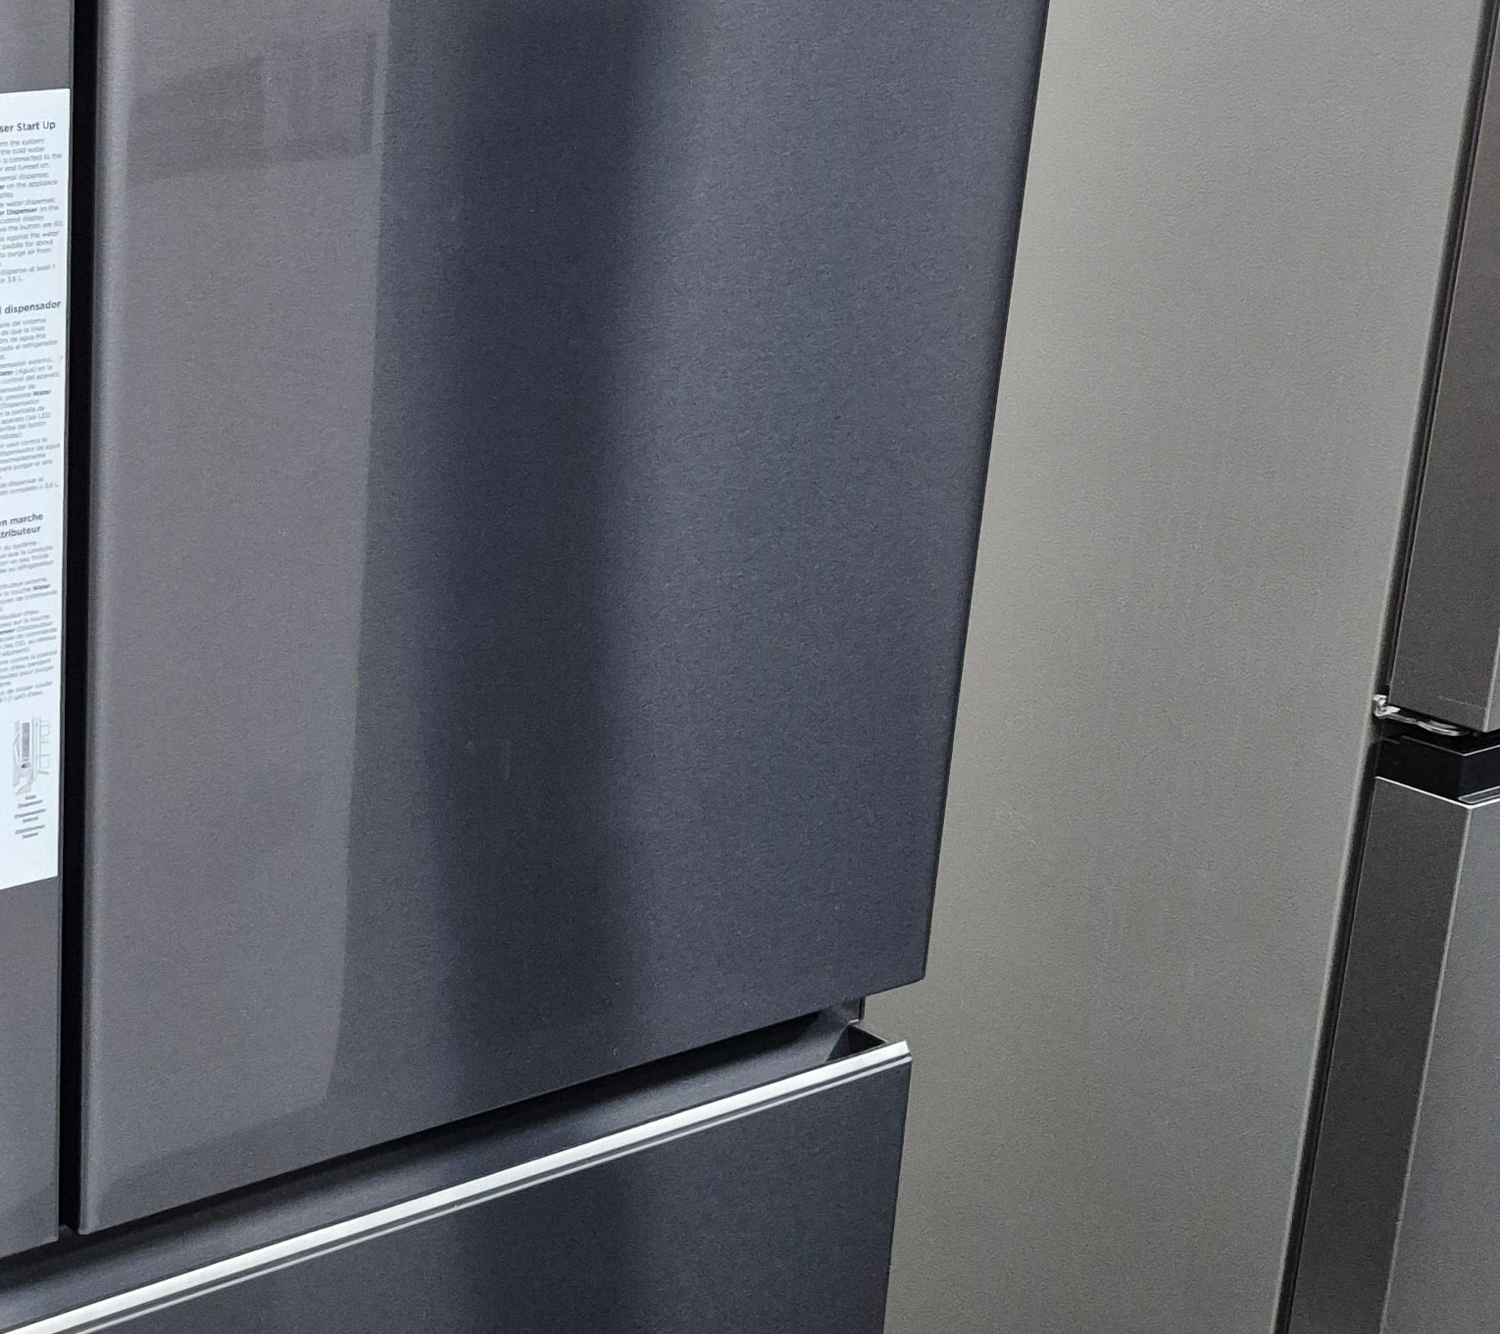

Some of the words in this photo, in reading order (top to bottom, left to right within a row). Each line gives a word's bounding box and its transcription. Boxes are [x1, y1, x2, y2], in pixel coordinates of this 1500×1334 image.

[17, 122, 40, 131] Start
[42, 121, 56, 130] Up
[4, 301, 61, 314] dispensador
[10, 514, 43, 524] marche
